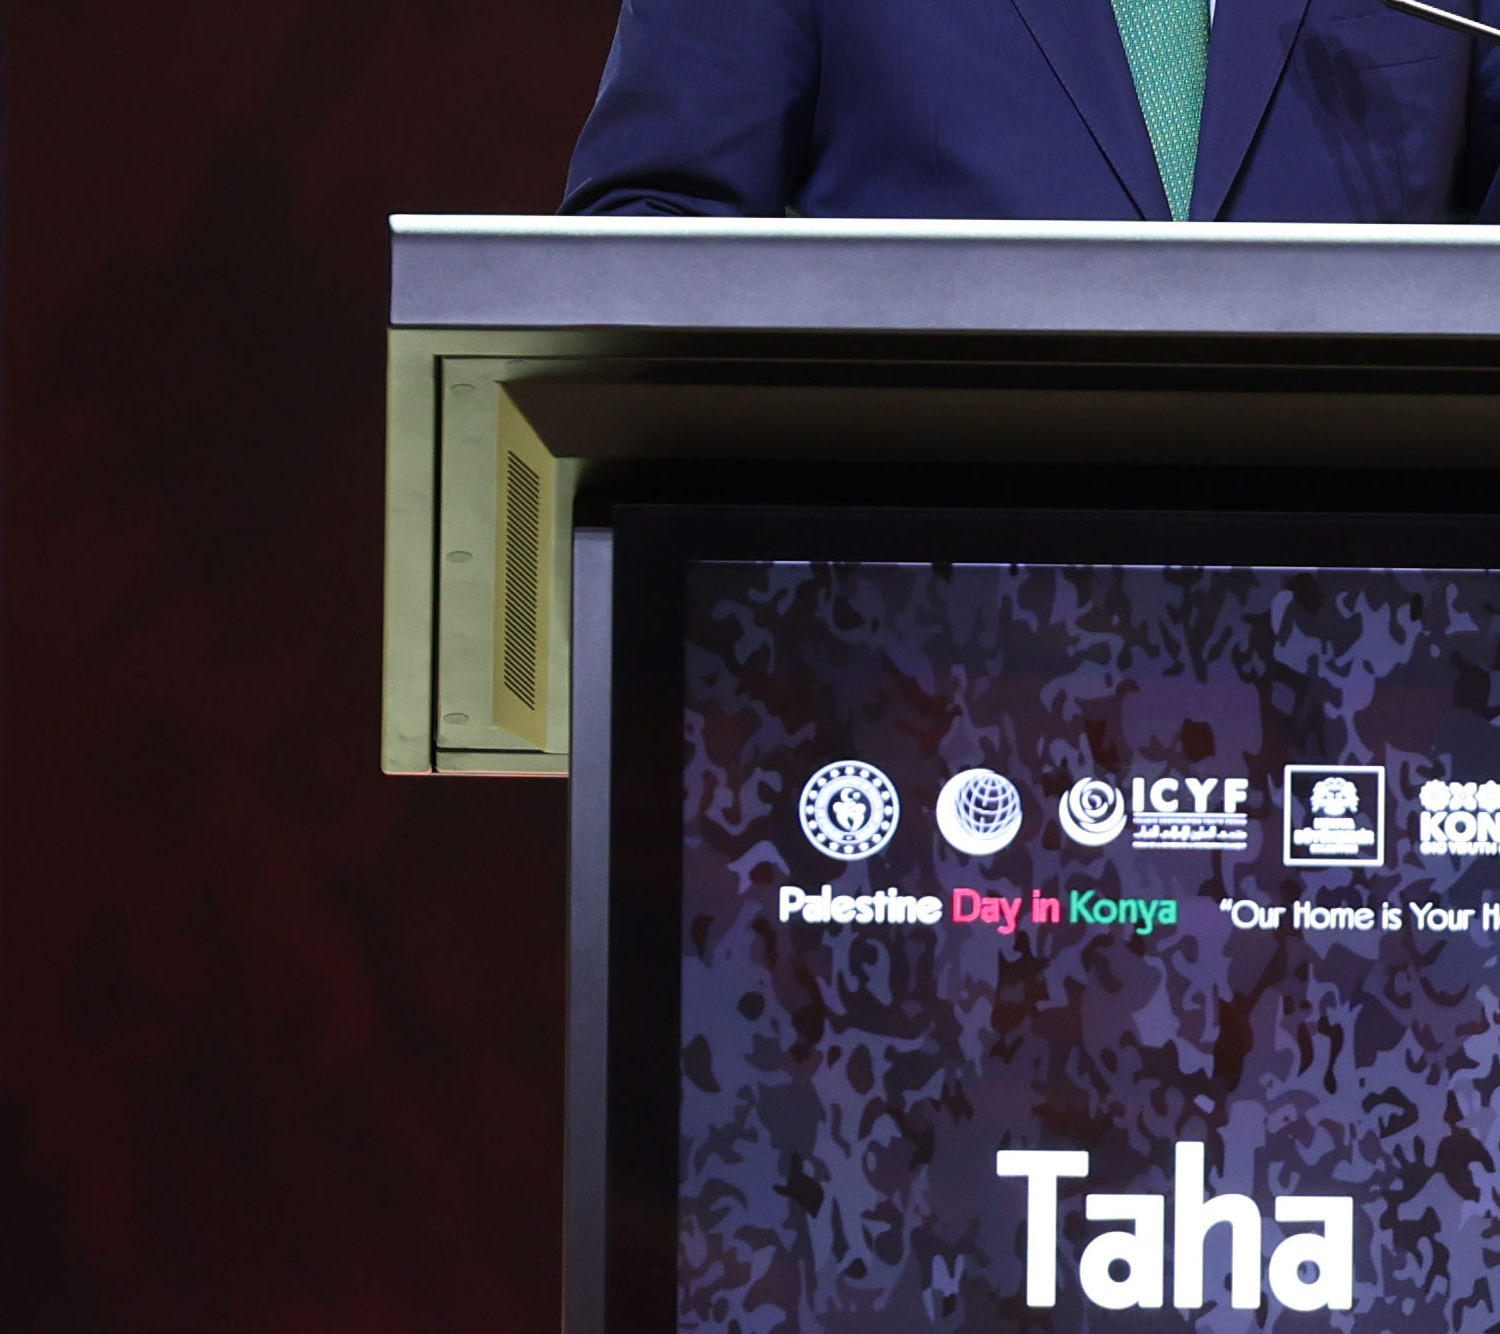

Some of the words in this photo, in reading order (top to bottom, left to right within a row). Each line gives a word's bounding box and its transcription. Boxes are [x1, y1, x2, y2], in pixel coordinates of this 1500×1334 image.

[1132, 777, 1249, 813] ICYF
[779, 884, 943, 925] Palestine
[952, 887, 1022, 935] Day
[1031, 888, 1061, 924] in
[1069, 889, 1179, 936] Konya
[1219, 898, 1287, 929] “Our
[1293, 900, 1375, 930] Home
[1381, 901, 1403, 931] is
[1409, 901, 1476, 931] Your
[996, 1141, 1354, 1312] Taha
